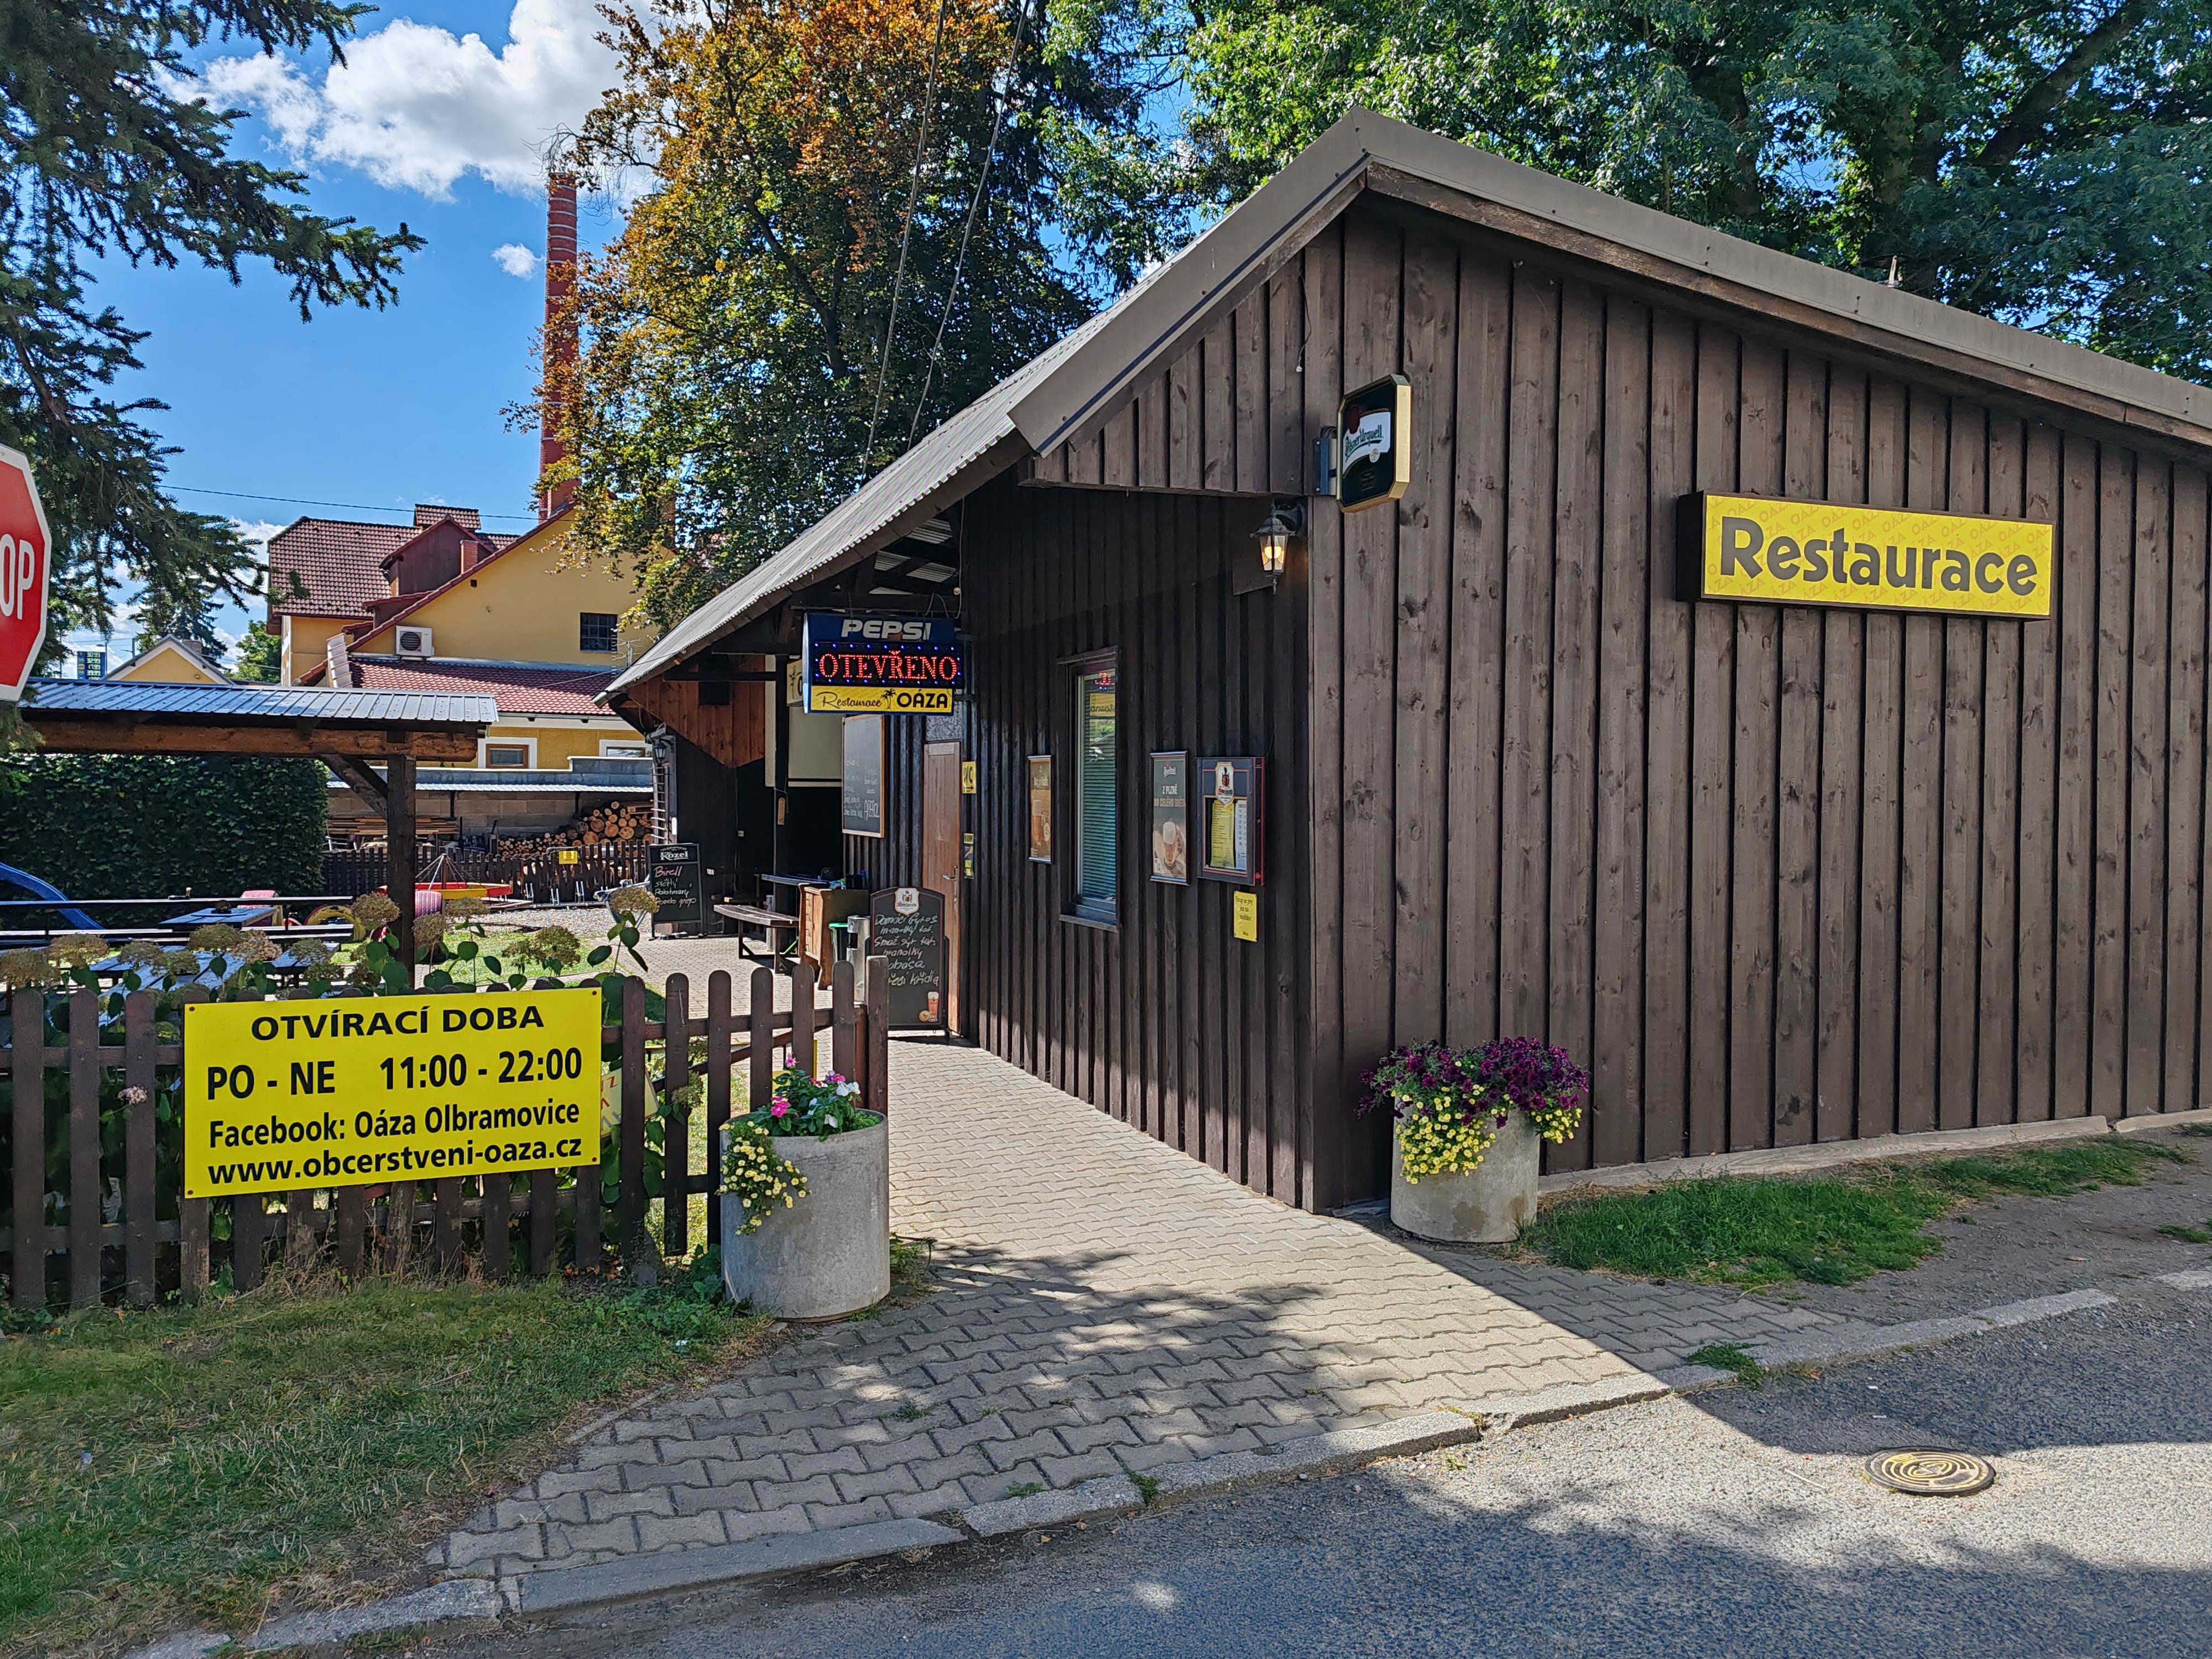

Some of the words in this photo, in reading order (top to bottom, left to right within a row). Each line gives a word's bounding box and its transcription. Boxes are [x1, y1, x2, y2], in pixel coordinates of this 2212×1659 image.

[1720, 516, 2038, 596] Restaurace
[0, 533, 35, 620] OP
[841, 619, 932, 640] PEPSI
[819, 650, 958, 680] OTEVŘENO
[816, 691, 883, 709] Restaurace
[896, 689, 948, 708] OÁZA
[654, 865, 682, 878] Birell
[660, 851, 688, 860] Kozel
[251, 1005, 430, 1041] OTVÍRACÍ
[443, 1005, 544, 1032] DOBA
[207, 1065, 254, 1100] PO
[290, 1060, 335, 1095] NE
[379, 1053, 467, 1090] 11:00
[498, 1047, 582, 1083] 22:00
[210, 1112, 345, 1148] Facebook:
[354, 1109, 416, 1138] Oáza
[425, 1098, 580, 1133] Olbramovice
[207, 1138, 582, 1185] www.obcerstveni-oaza.cz
